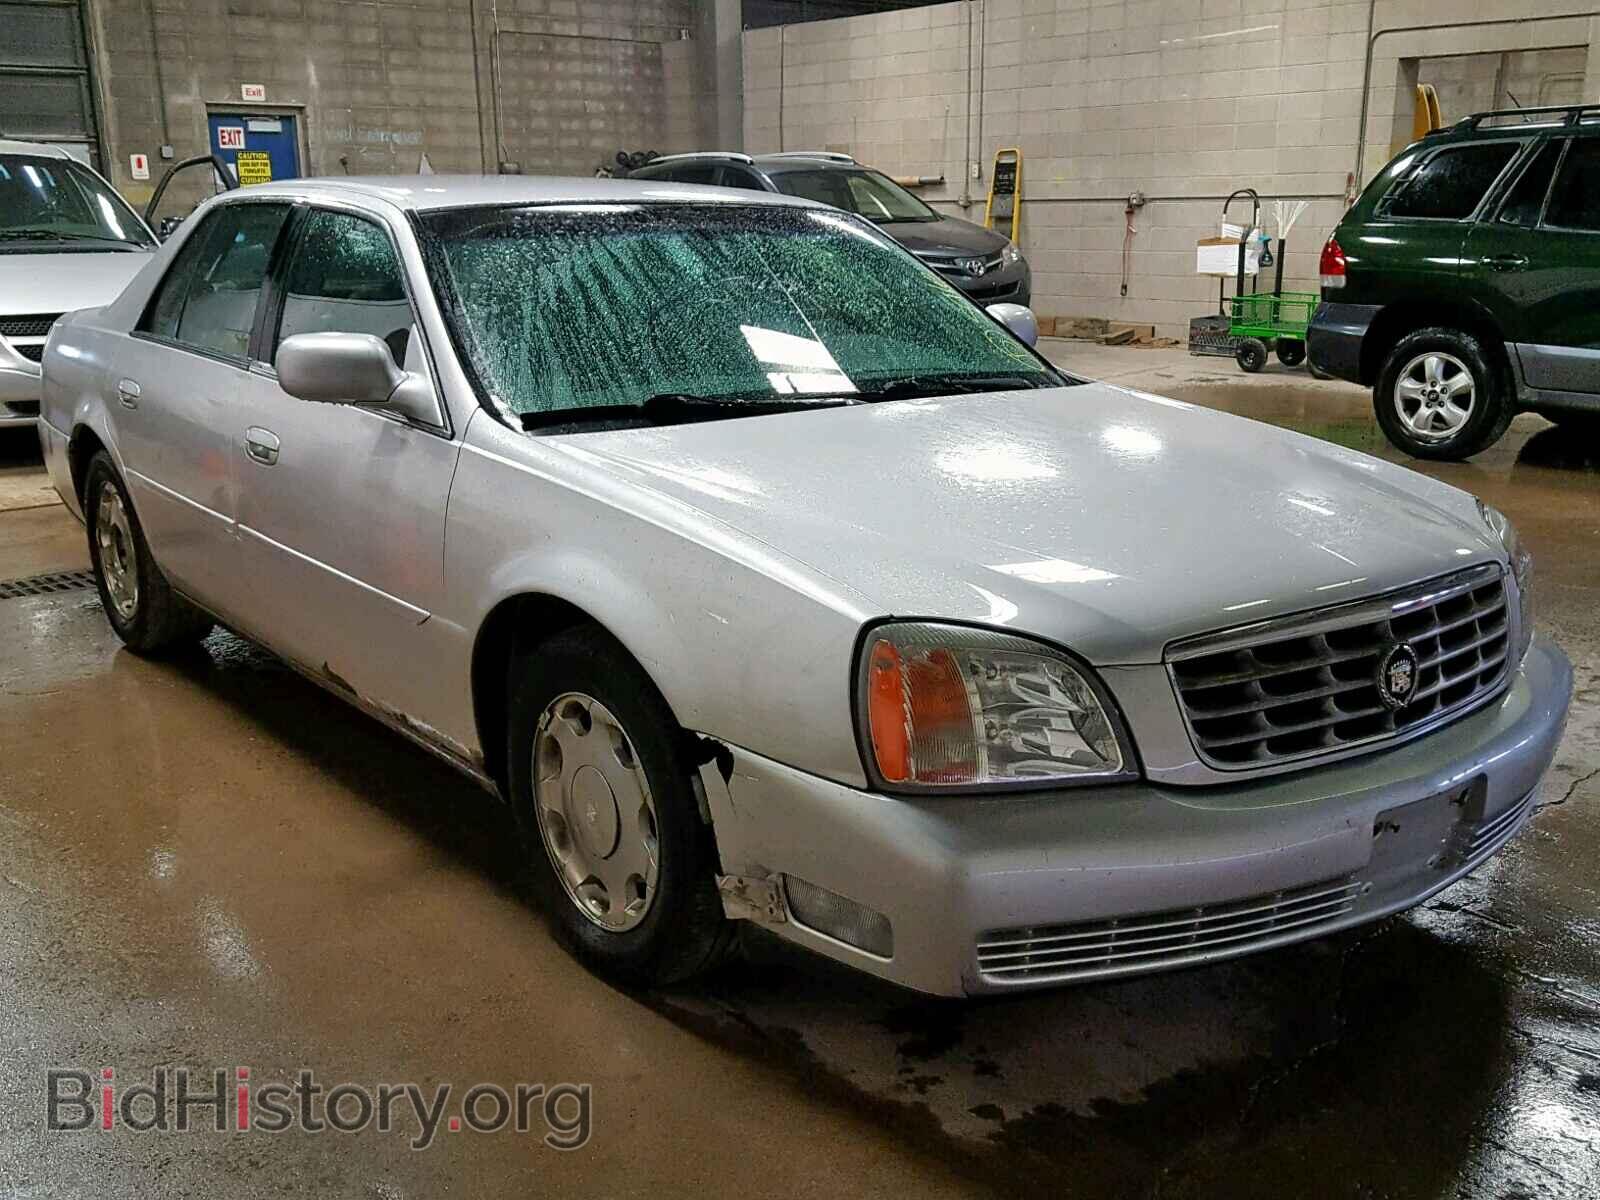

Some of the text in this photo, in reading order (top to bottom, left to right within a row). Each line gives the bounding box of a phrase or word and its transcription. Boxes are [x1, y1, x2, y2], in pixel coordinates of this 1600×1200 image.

[245, 88, 262, 97] Exit
[220, 129, 242, 146] EXIT
[238, 152, 268, 160] CAUTION
